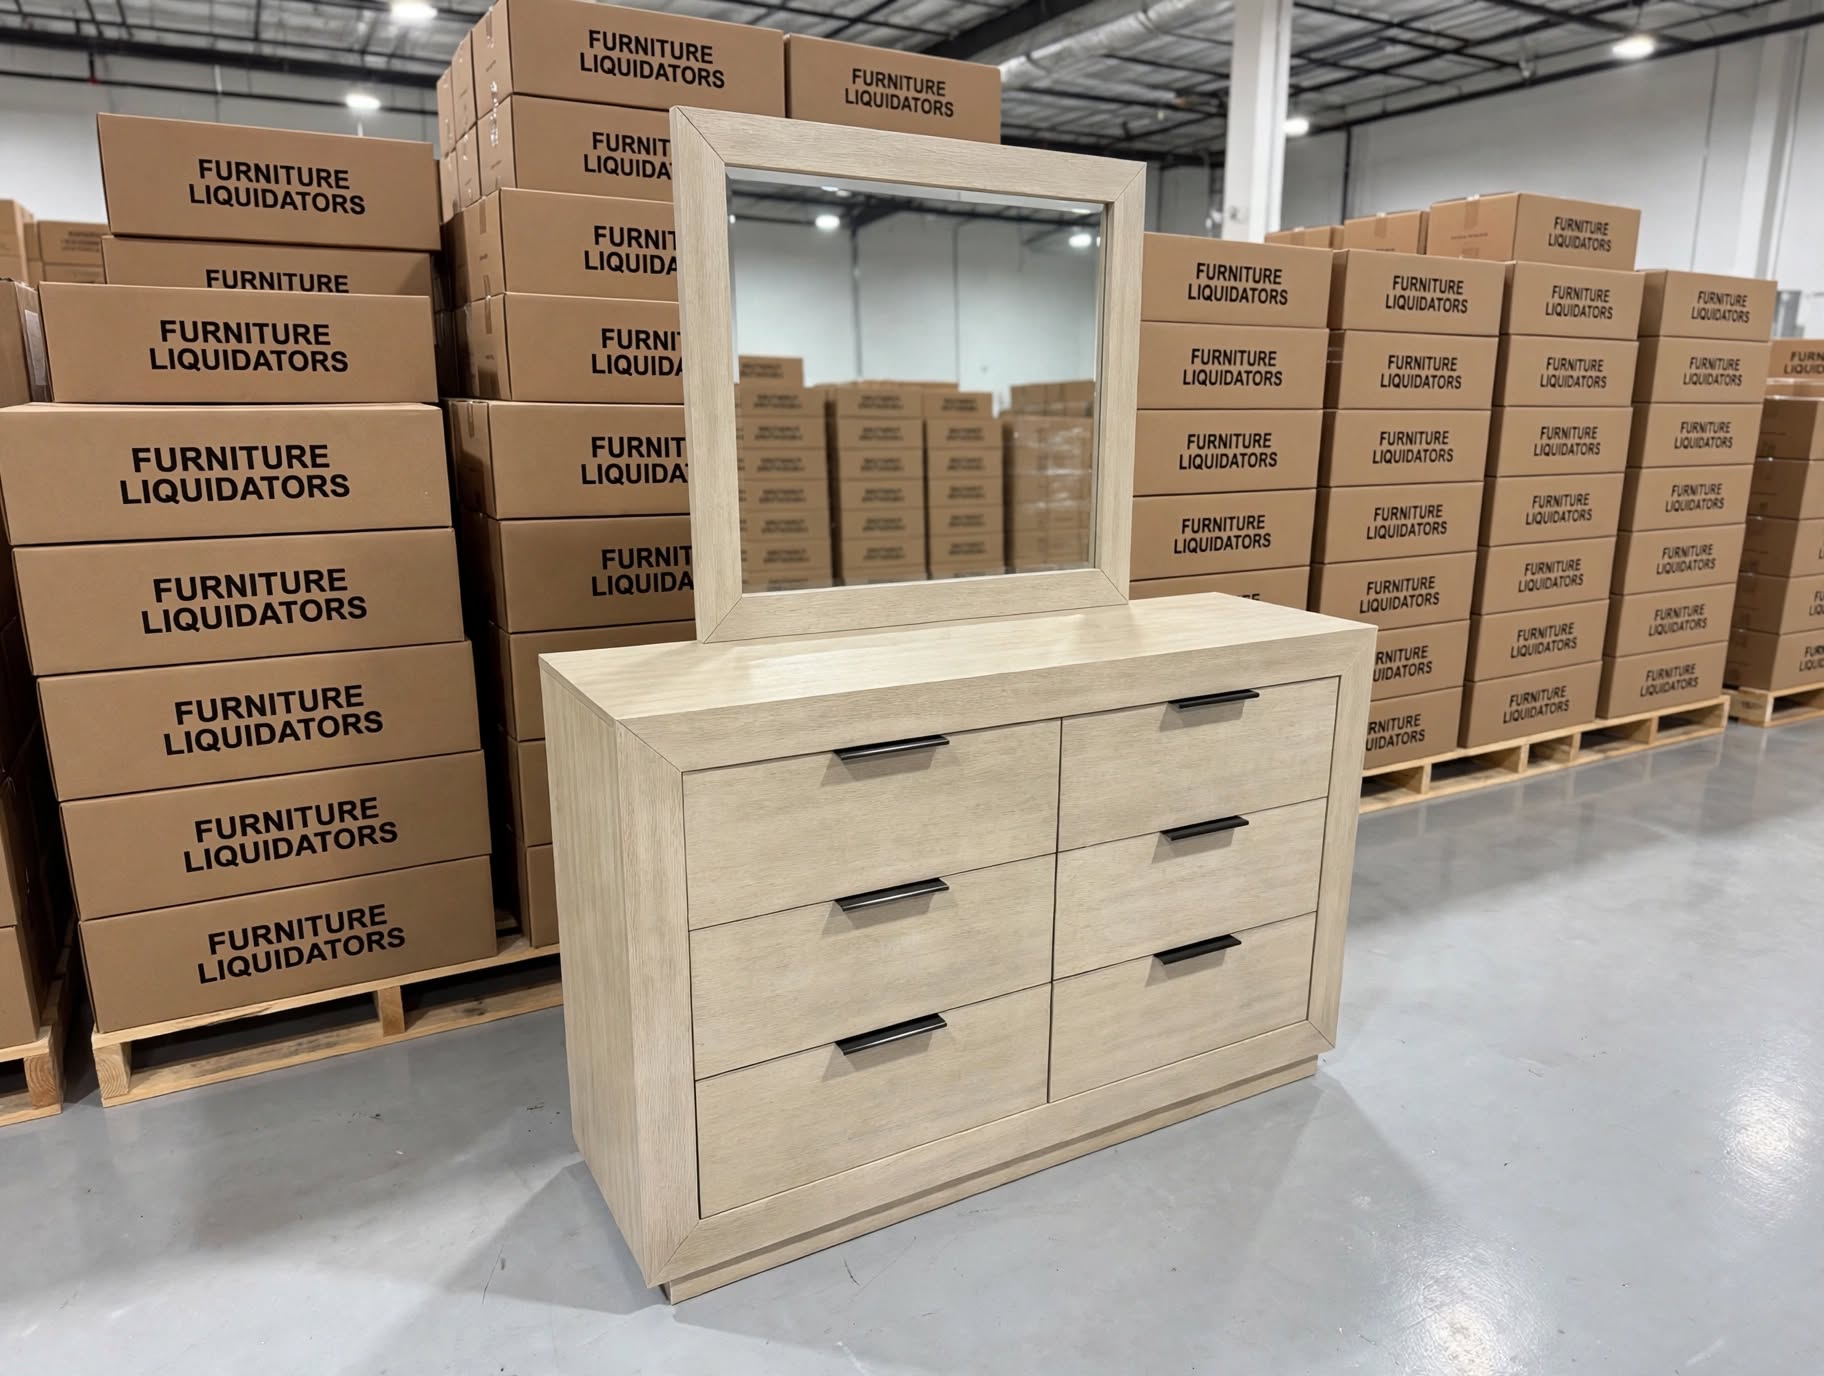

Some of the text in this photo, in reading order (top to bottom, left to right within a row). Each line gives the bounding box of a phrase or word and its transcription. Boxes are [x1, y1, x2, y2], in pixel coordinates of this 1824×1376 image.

[589, 30, 713, 64] FURNITURE
[580, 52, 724, 88] LIQUIDATORS
[853, 68, 945, 96] FURNITURE
[846, 88, 953, 117] LIQUIDATORS
[593, 132, 670, 157] FURNIT
[199, 159, 349, 189] FURNITURE
[584, 154, 671, 180] LIQUIDA
[189, 184, 365, 215] LIQUIDATORS
[1553, 216, 1609, 237] FURNITURE
[594, 226, 675, 250] FURNIT
[1547, 233, 1612, 253] LIQUIDATORS
[585, 251, 675, 275] LIQUIDA
[1196, 262, 1283, 285] FURNITURE
[206, 269, 349, 293] FURNITURE
[1392, 275, 1464, 296] FURNITURE
[1187, 283, 1288, 306] LIQUIDATORS
[1385, 293, 1468, 314] LIQUIDATORS
[1551, 284, 1611, 304] FURNITURE
[1697, 290, 1748, 308] FURNITURE
[1545, 301, 1614, 320] LIQUIDATORS
[1691, 306, 1750, 324] LIQUIDATORS
[160, 320, 331, 345] FURNITURE
[602, 328, 680, 351] FURNI
[150, 348, 348, 372] LIQUIDATORS
[592, 354, 681, 376] LIQUID
[1190, 348, 1277, 367] FURNITURE
[1387, 354, 1458, 372] FURNITURE
[1545, 356, 1604, 373] FURNITURE
[1689, 356, 1741, 372] FURNITURE
[1182, 368, 1283, 387] LIQUIDATORS
[1380, 373, 1462, 390] LIQUIDATORS
[1539, 373, 1607, 389] LIQUIDATORS
[1682, 372, 1743, 387] LIQUIDATORS
[1379, 430, 1449, 446] FURNITURE
[1539, 426, 1599, 441] FURNITURE
[1679, 421, 1731, 434] FURNITURE
[592, 437, 685, 458] FURNIT
[1186, 432, 1272, 451] FURNITURE
[1533, 442, 1601, 457] LIQUIDATORS
[1674, 436, 1734, 450] LIQUIDATORS
[132, 445, 330, 472] FURNITURE
[1179, 451, 1278, 471] LIQUIDATORS
[1372, 448, 1454, 465] LIQUIDATORS
[581, 463, 687, 485] LIQUIDA
[120, 474, 349, 504] LIQUIDATORS
[1670, 482, 1723, 498] FURNITURE
[1531, 492, 1590, 509] FURNITURE
[1665, 497, 1725, 513] LIQUIDATORS
[1373, 504, 1444, 522] FURNITURE
[1525, 508, 1593, 526] LIQUIDATORS
[1181, 514, 1266, 535] FURNITURE
[1366, 520, 1448, 540] LIQUIDATORS
[1173, 532, 1272, 555] LIQUIDATORS
[1661, 543, 1713, 560] FURNITURE
[602, 546, 692, 570] FURNIT
[1524, 558, 1582, 577] FURNITURE
[1656, 557, 1717, 576] LIQUIDATORS
[154, 568, 347, 602] FURNITURE
[592, 571, 692, 596] LIQUIDA
[1366, 575, 1436, 596] FURNITURE
[1517, 573, 1584, 593] LIQUIDATORS
[1359, 591, 1440, 614] LIQUIDATORS
[1653, 603, 1705, 622] FURNITURE
[142, 596, 367, 634] LIQUIDATORS
[1516, 622, 1575, 643] FURNITURE
[1647, 617, 1708, 637] LIQUIDATORS
[1375, 645, 1429, 666] RNITURE
[1510, 636, 1577, 659] LIQUIDATORS
[1373, 660, 1433, 683] UIDATORS
[1645, 663, 1697, 682] FURNITURE
[1508, 685, 1567, 708] FURNITURE
[1639, 676, 1699, 698] LIQUIDATORS
[175, 685, 364, 725] FURNITURE
[1502, 699, 1570, 725] LIQUIDATORS
[164, 711, 383, 755] LIQUIDATORS
[1367, 713, 1421, 736] RNITURE
[1366, 728, 1425, 752] UIDATORS
[195, 797, 379, 843] FURNITURE
[184, 822, 398, 873] LIQUIDATORS
[208, 904, 388, 956] FURNITURE
[198, 927, 405, 985] LIQUIDATORS
